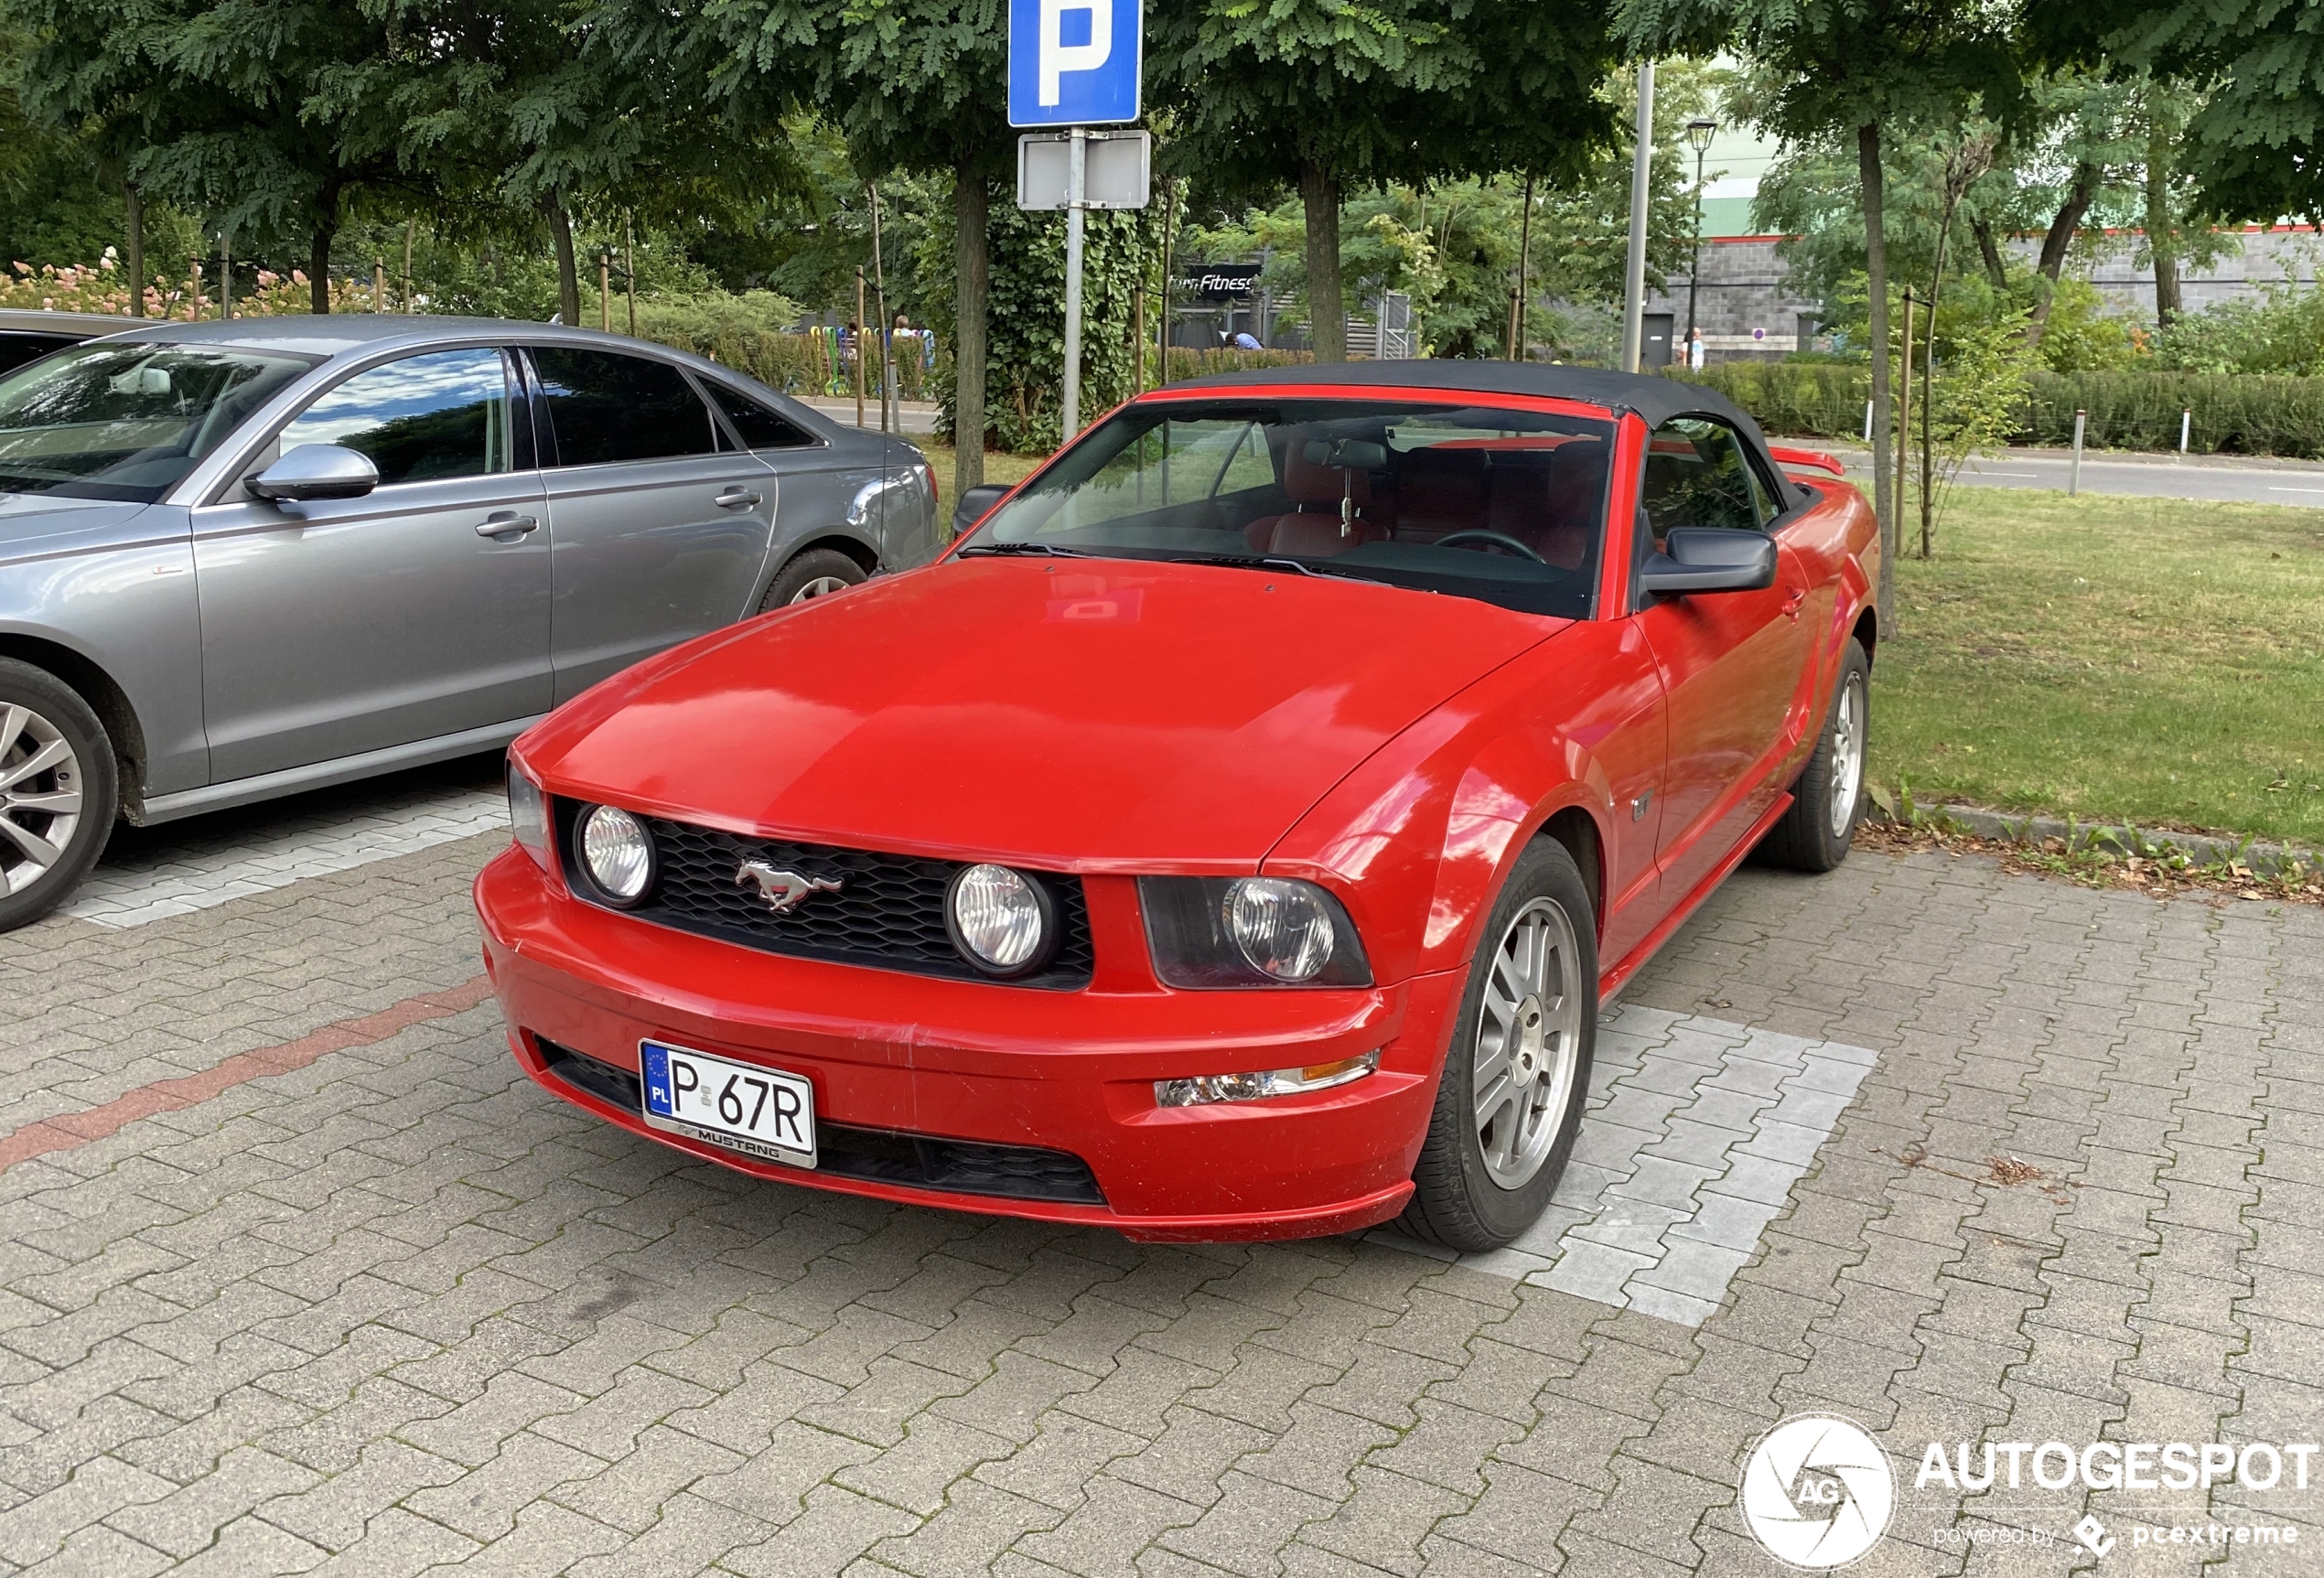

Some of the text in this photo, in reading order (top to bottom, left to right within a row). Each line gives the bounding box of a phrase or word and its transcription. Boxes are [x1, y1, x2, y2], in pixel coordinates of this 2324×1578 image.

[1038, 0, 1113, 106] P
[1200, 274, 1253, 290] Fitness
[651, 1087, 669, 1103] PL
[672, 1058, 803, 1143] P 67R
[698, 1130, 780, 1159] MUSTANG
